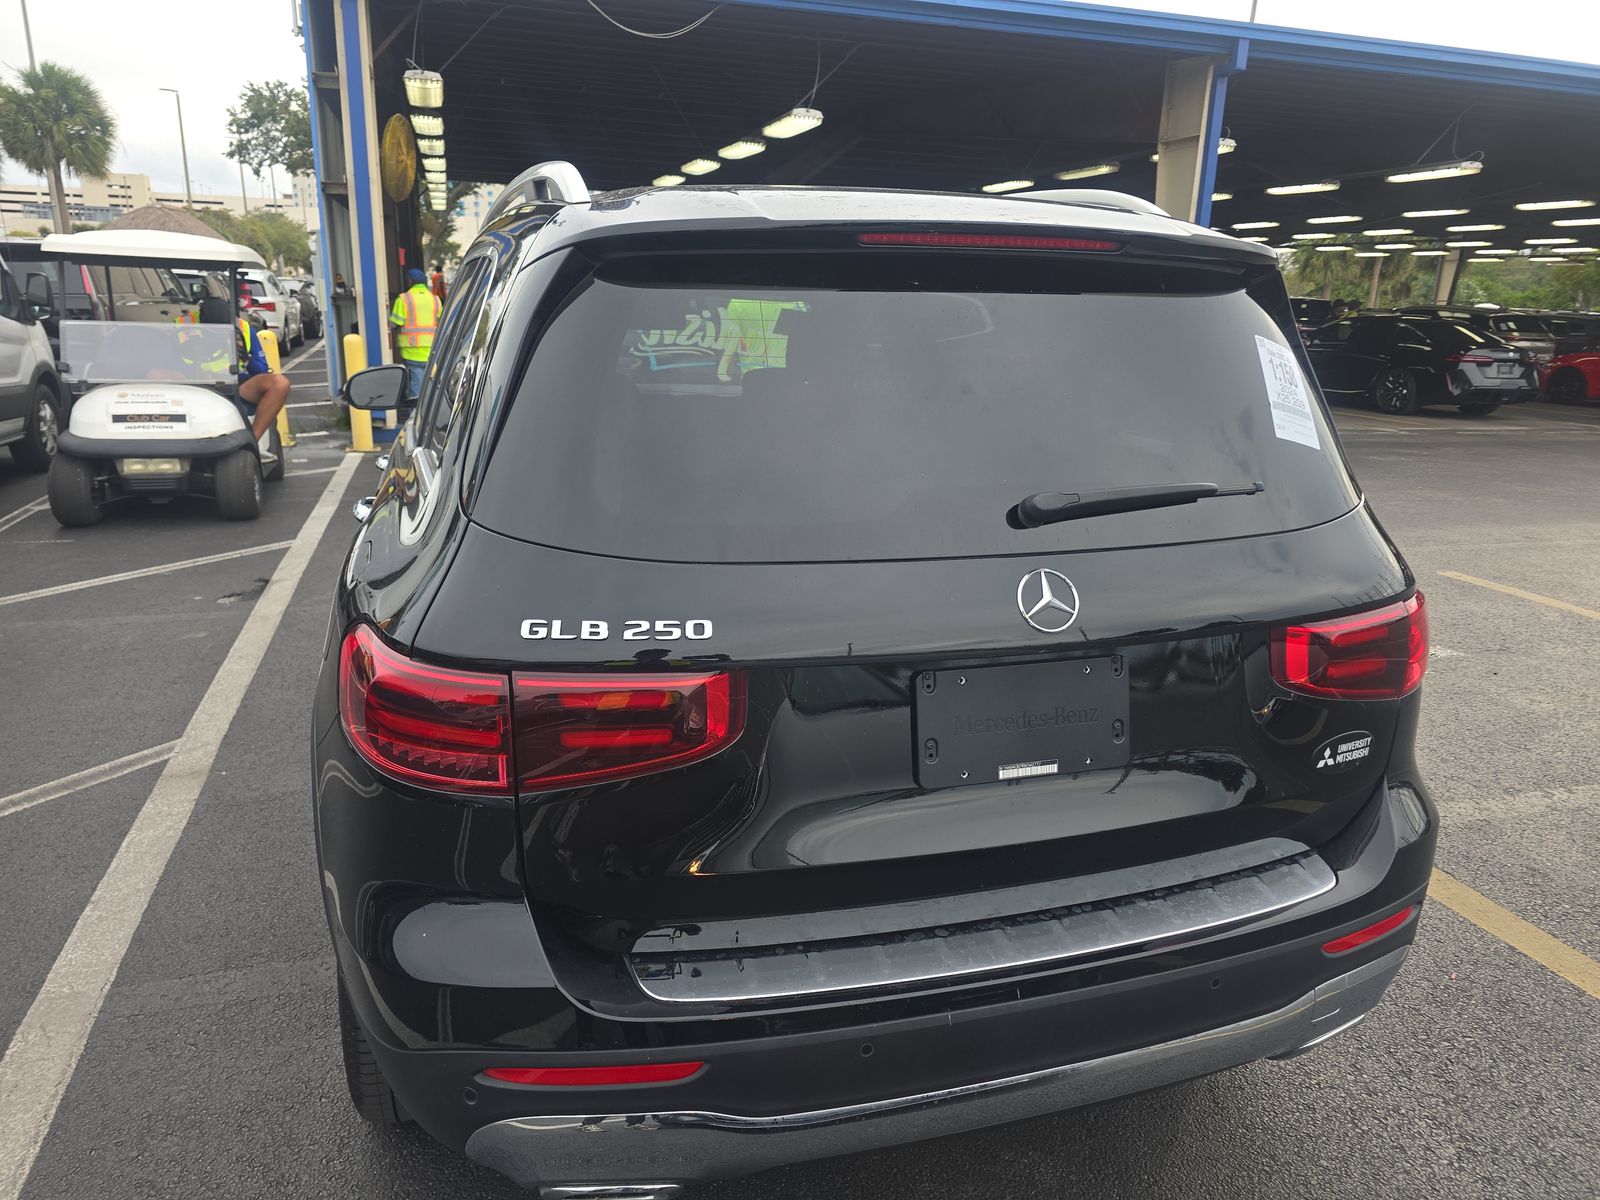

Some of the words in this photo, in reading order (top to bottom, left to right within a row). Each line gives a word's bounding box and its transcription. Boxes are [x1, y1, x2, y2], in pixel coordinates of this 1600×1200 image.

[126, 414, 150, 422] Club
[151, 414, 170, 422] Car
[520, 619, 609, 641] GLB
[622, 619, 713, 641] 250
[953, 706, 1100, 736] Mercedes-Benz
[1337, 736, 1373, 754] UNIVERSITY
[1335, 746, 1370, 764] MITSUBISHI
